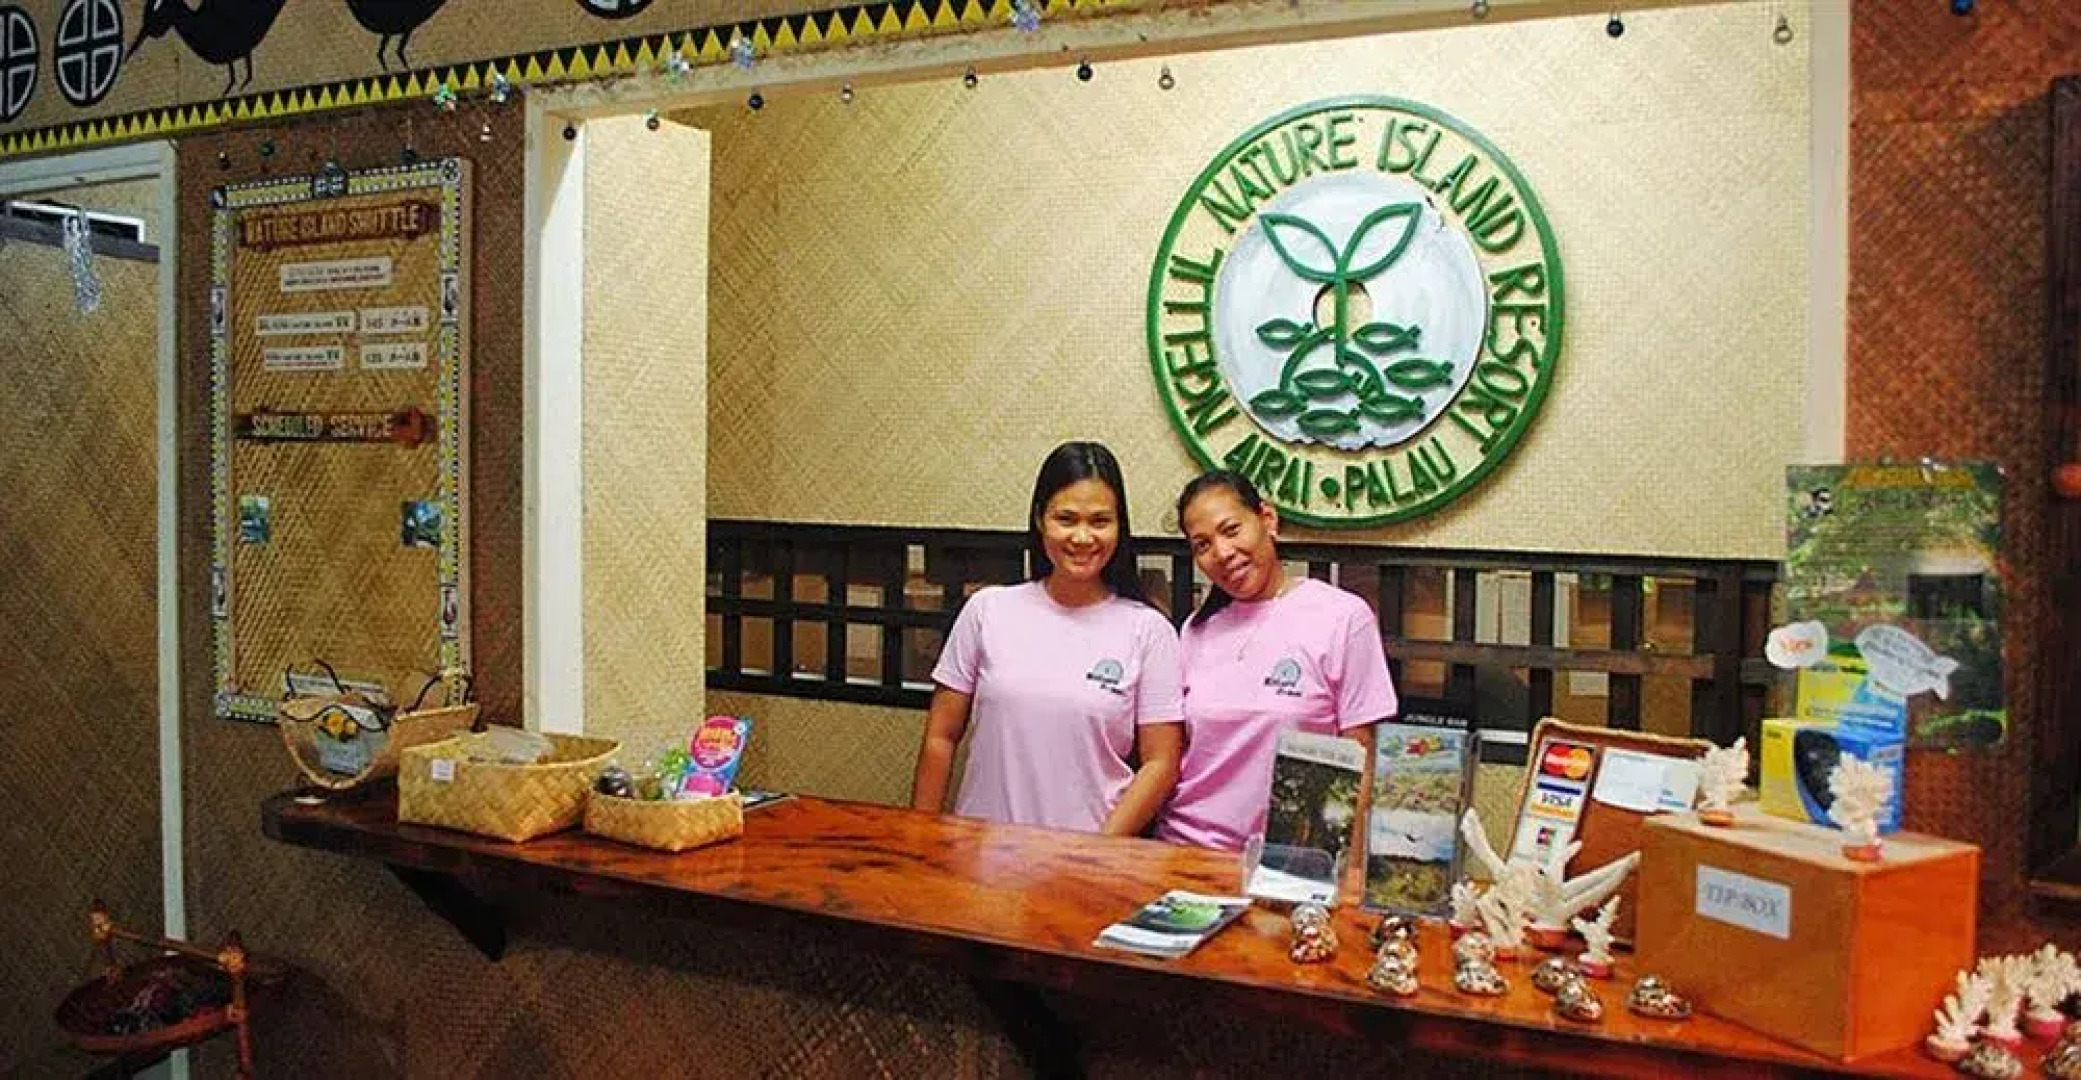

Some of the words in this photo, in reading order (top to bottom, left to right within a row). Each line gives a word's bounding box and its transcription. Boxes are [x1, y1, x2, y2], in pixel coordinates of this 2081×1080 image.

[1201, 114, 1359, 233] NATURE
[1376, 117, 1526, 253] ISLAND
[1449, 261, 1547, 454] RESORT
[330, 414, 393, 438] SERVICE
[1223, 433, 1313, 508] AIRAI
[1345, 437, 1456, 510] PALAU
[1705, 881, 1738, 906] TIP
[1740, 892, 1782, 917] BOX
